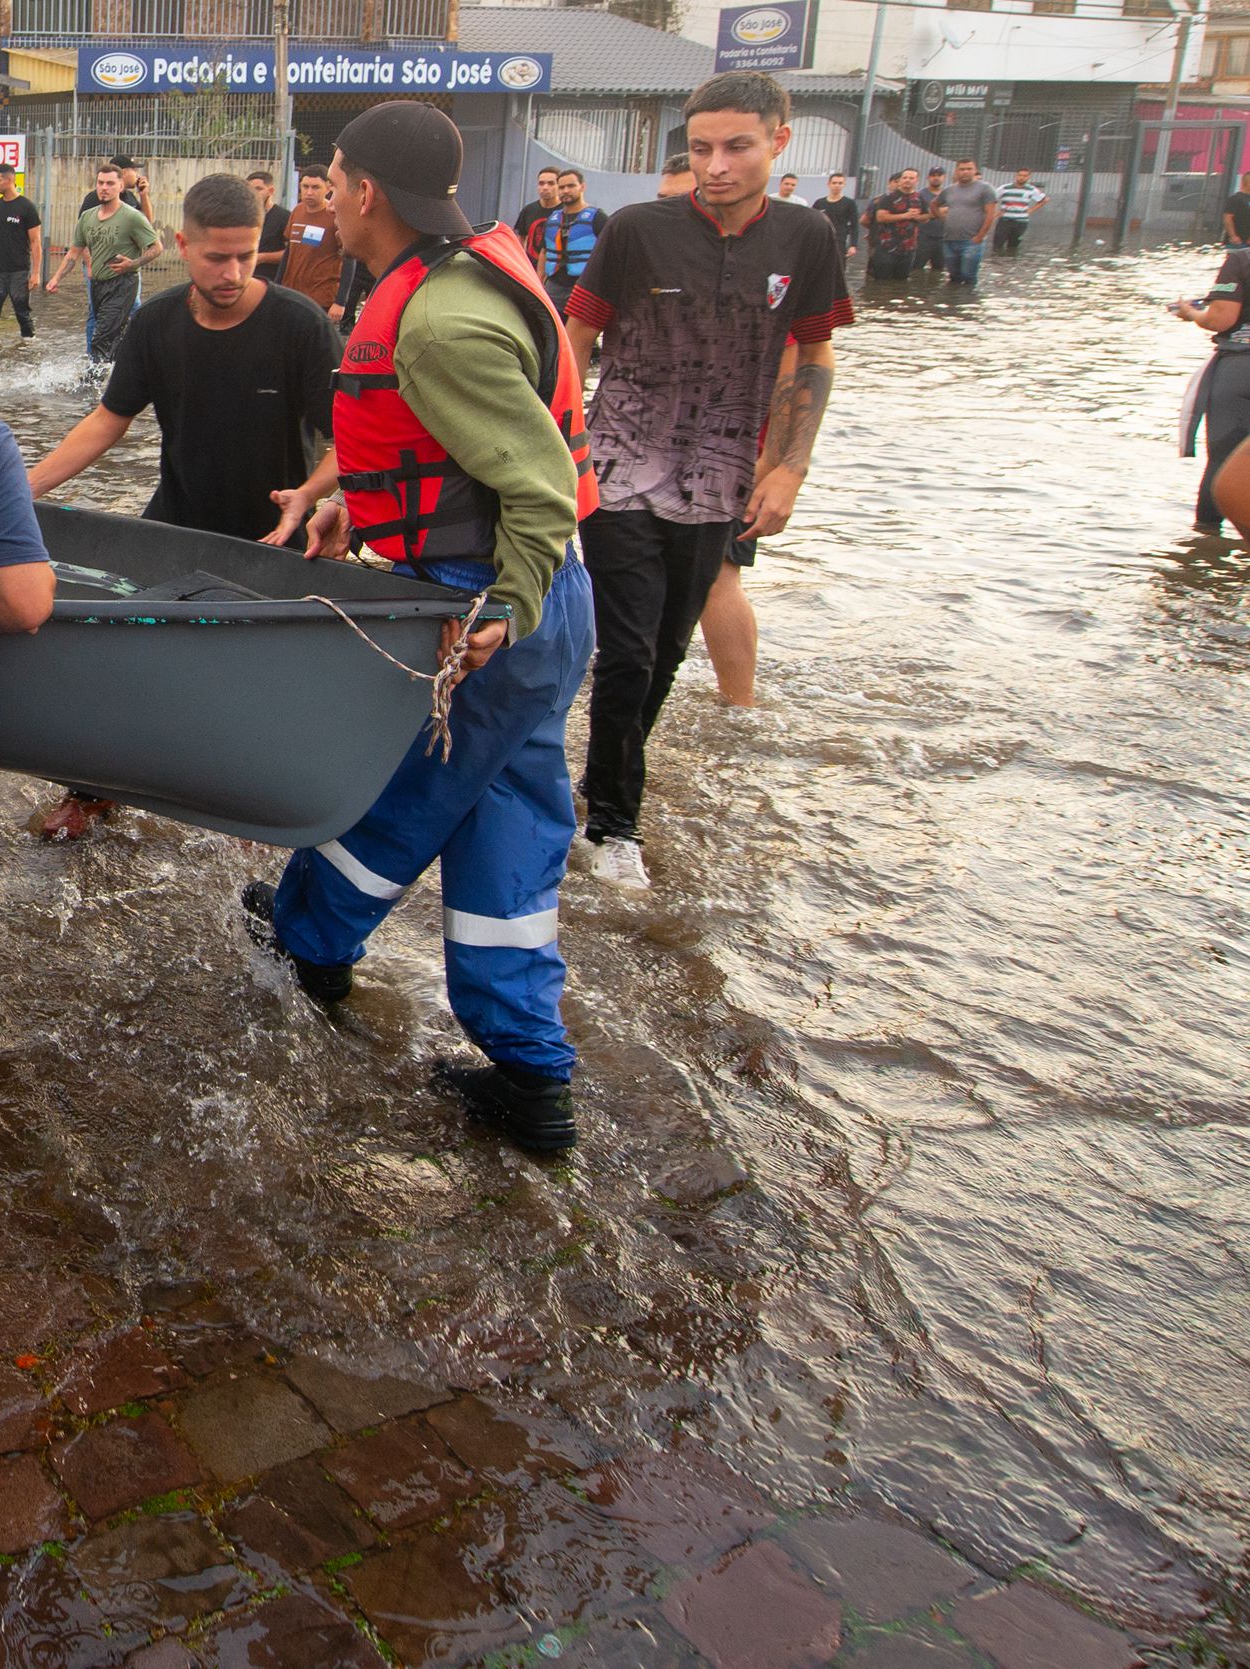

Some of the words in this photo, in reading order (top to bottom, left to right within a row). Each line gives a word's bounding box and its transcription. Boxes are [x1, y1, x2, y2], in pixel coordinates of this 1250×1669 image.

[740, 19, 759, 31] São
[760, 18, 782, 31] José
[719, 47, 748, 59] Padaria
[756, 43, 798, 56] Confeitaria
[100, 62, 117, 73] São
[119, 62, 140, 74] José
[154, 54, 247, 84] Padaria
[253, 62, 267, 83] e
[273, 55, 394, 84] onfeitaria
[402, 58, 441, 84] São
[446, 58, 492, 89] José
